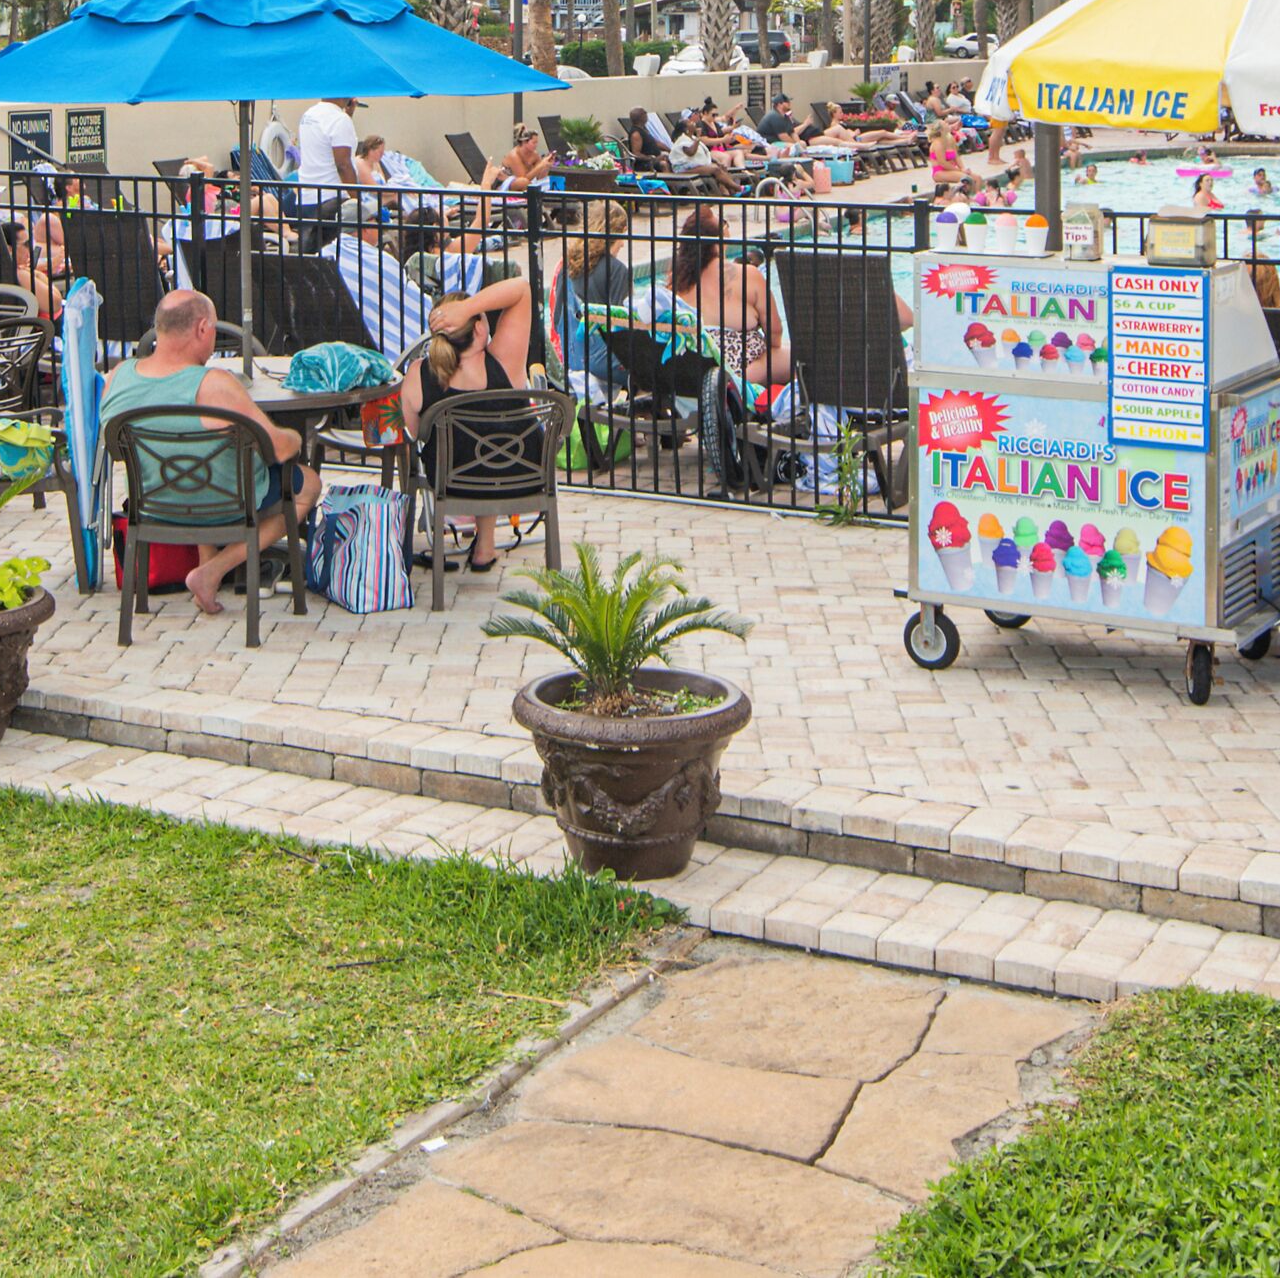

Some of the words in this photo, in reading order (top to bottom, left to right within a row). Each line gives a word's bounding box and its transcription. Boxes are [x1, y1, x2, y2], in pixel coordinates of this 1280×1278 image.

[1037, 82, 1135, 115] ITALIAN
[1142, 90, 1188, 119] ICE
[12, 120, 21, 134] NO
[22, 119, 49, 133] RUNNING
[70, 115, 78, 126] NO
[79, 114, 101, 125] OUTSIDE
[72, 125, 101, 136] ALCOHOLIC
[71, 135, 101, 147] BEVERAGES
[1064, 232, 1088, 242] Tips
[1011, 280, 1108, 297] RICCIARDI'S
[1115, 277, 1154, 290] CASH
[1159, 280, 1199, 293] ONLY
[956, 291, 1095, 321] ITALIAN
[1135, 301, 1145, 309] A
[1148, 301, 1176, 310] CUP
[1122, 320, 1193, 334] STRAWBERRY
[1126, 340, 1190, 357] MANGO
[1127, 361, 1192, 379] CHERRY
[1122, 383, 1158, 394] COTTON
[1162, 386, 1195, 397] CANDY
[929, 404, 978, 425] Delicious
[1123, 405, 1153, 415] SOUR
[1157, 407, 1193, 419] APPLE
[931, 425, 940, 440] &
[942, 418, 983, 438] Healthy
[1129, 425, 1188, 441] LEMON
[997, 434, 1116, 462] RICCIARDI'S
[931, 450, 1100, 503] ITALIAN
[1116, 468, 1190, 511] ICE
[1054, 502, 1075, 511] Made
[1077, 504, 1098, 513] From
[1098, 505, 1119, 515] Fresh
[1149, 511, 1169, 522] Dairy
